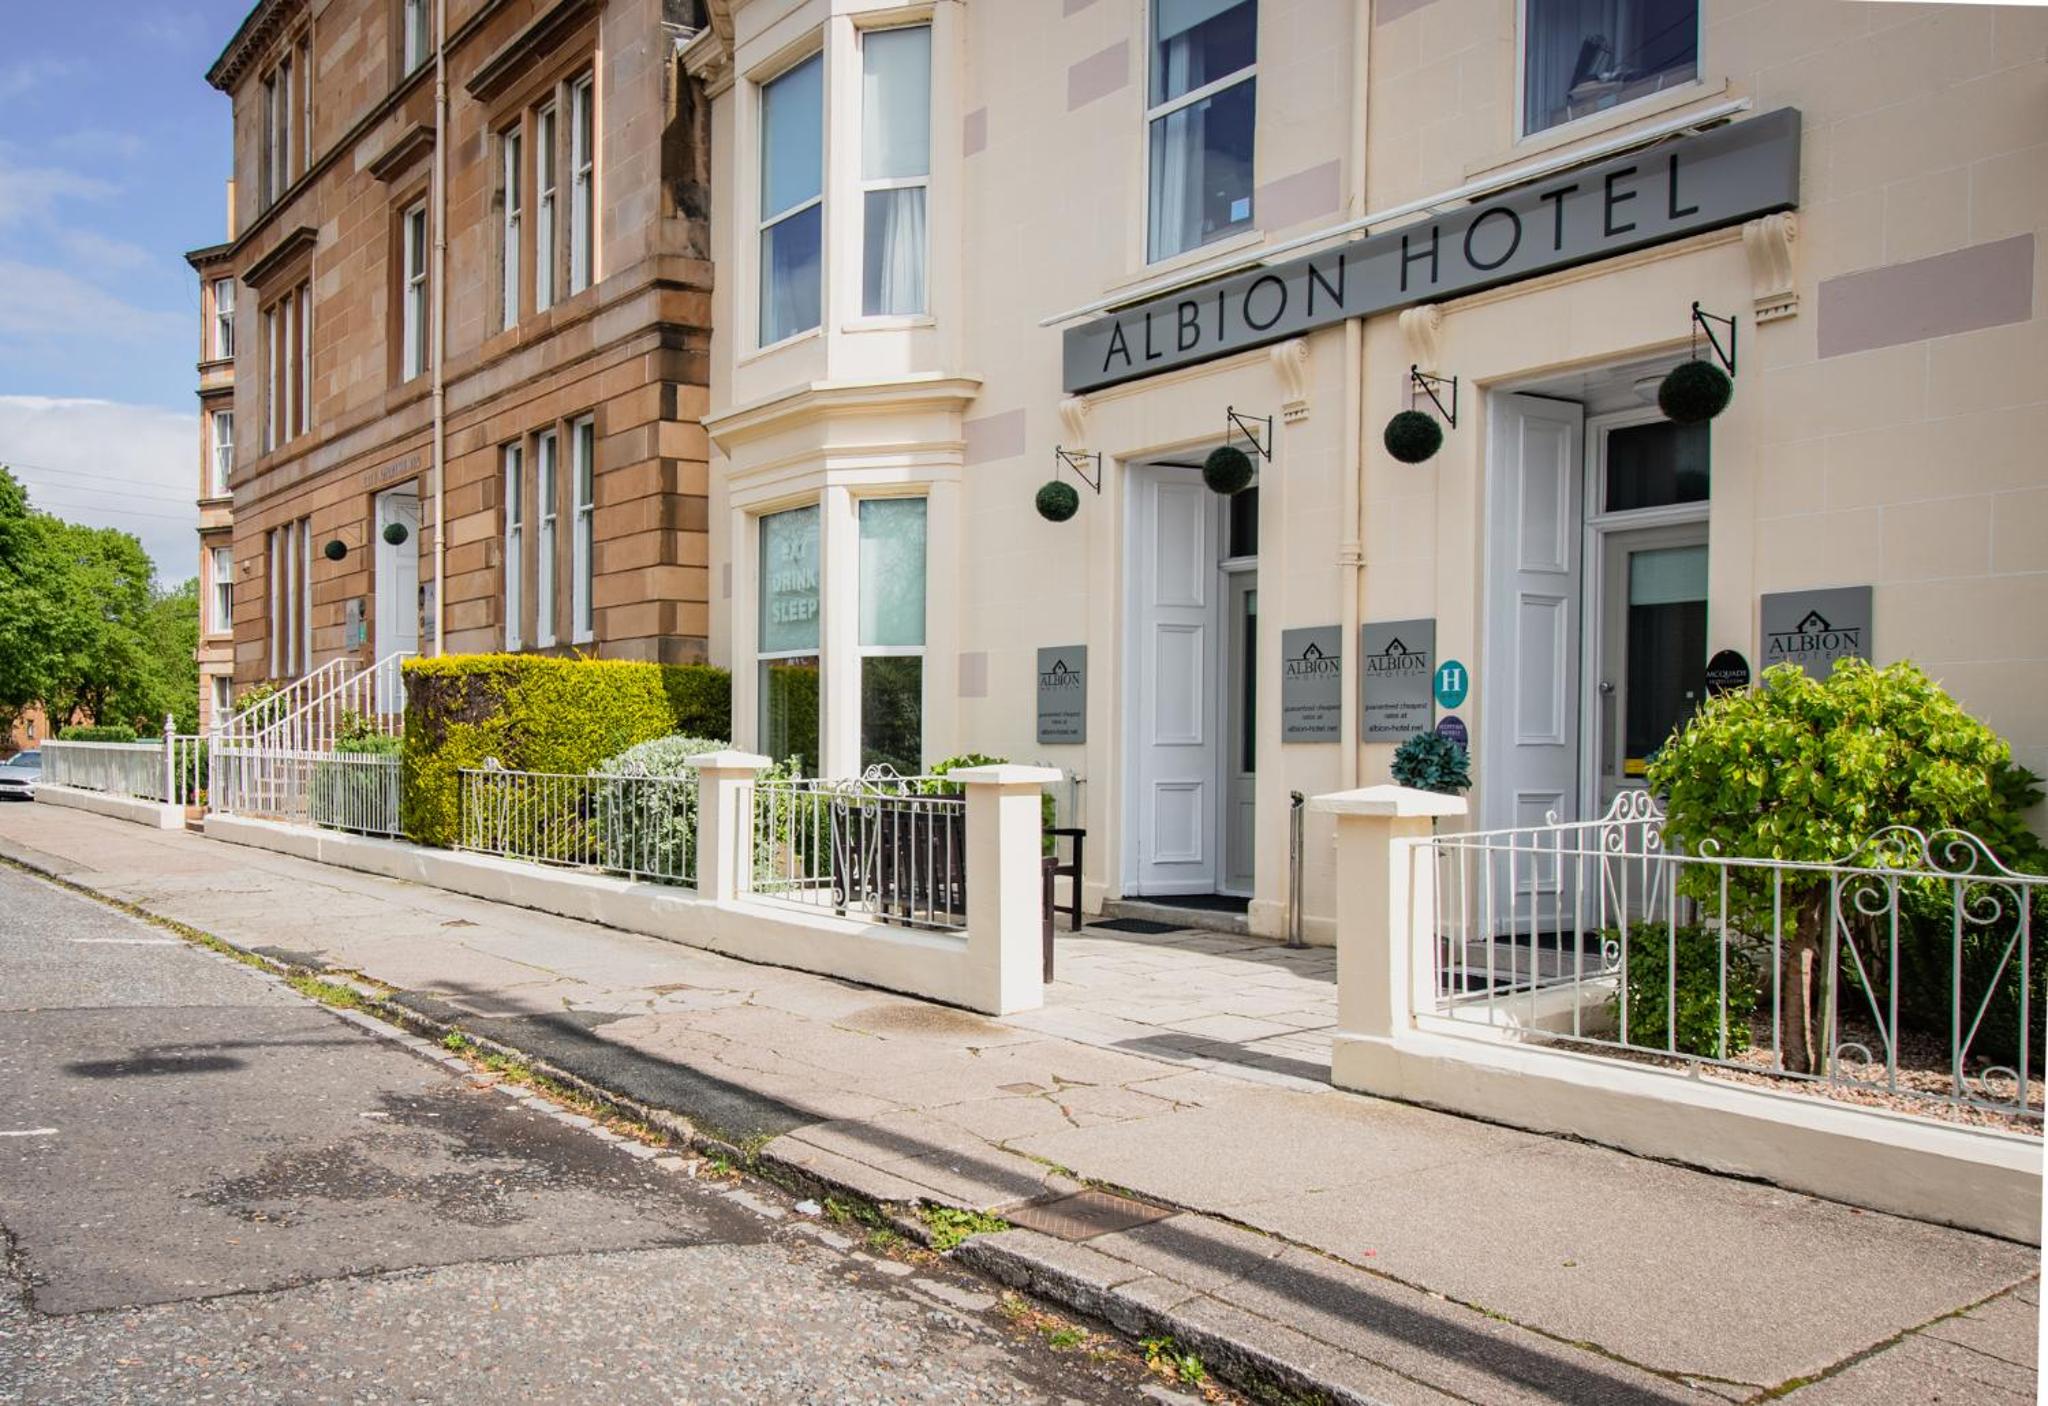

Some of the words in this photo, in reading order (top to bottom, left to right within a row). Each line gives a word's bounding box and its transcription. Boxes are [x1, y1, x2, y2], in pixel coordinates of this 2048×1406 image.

[1102, 254, 1346, 374] ALBION
[1400, 153, 1700, 293] HOTEL
[772, 567, 817, 592] DRINK
[772, 599, 817, 623] SLEEP
[1769, 631, 1859, 654] ALBION
[1287, 660, 1340, 675] ALBION
[1367, 656, 1426, 672] ALBION
[1041, 674, 1079, 686] ALBION
[1441, 668, 1462, 692] H
